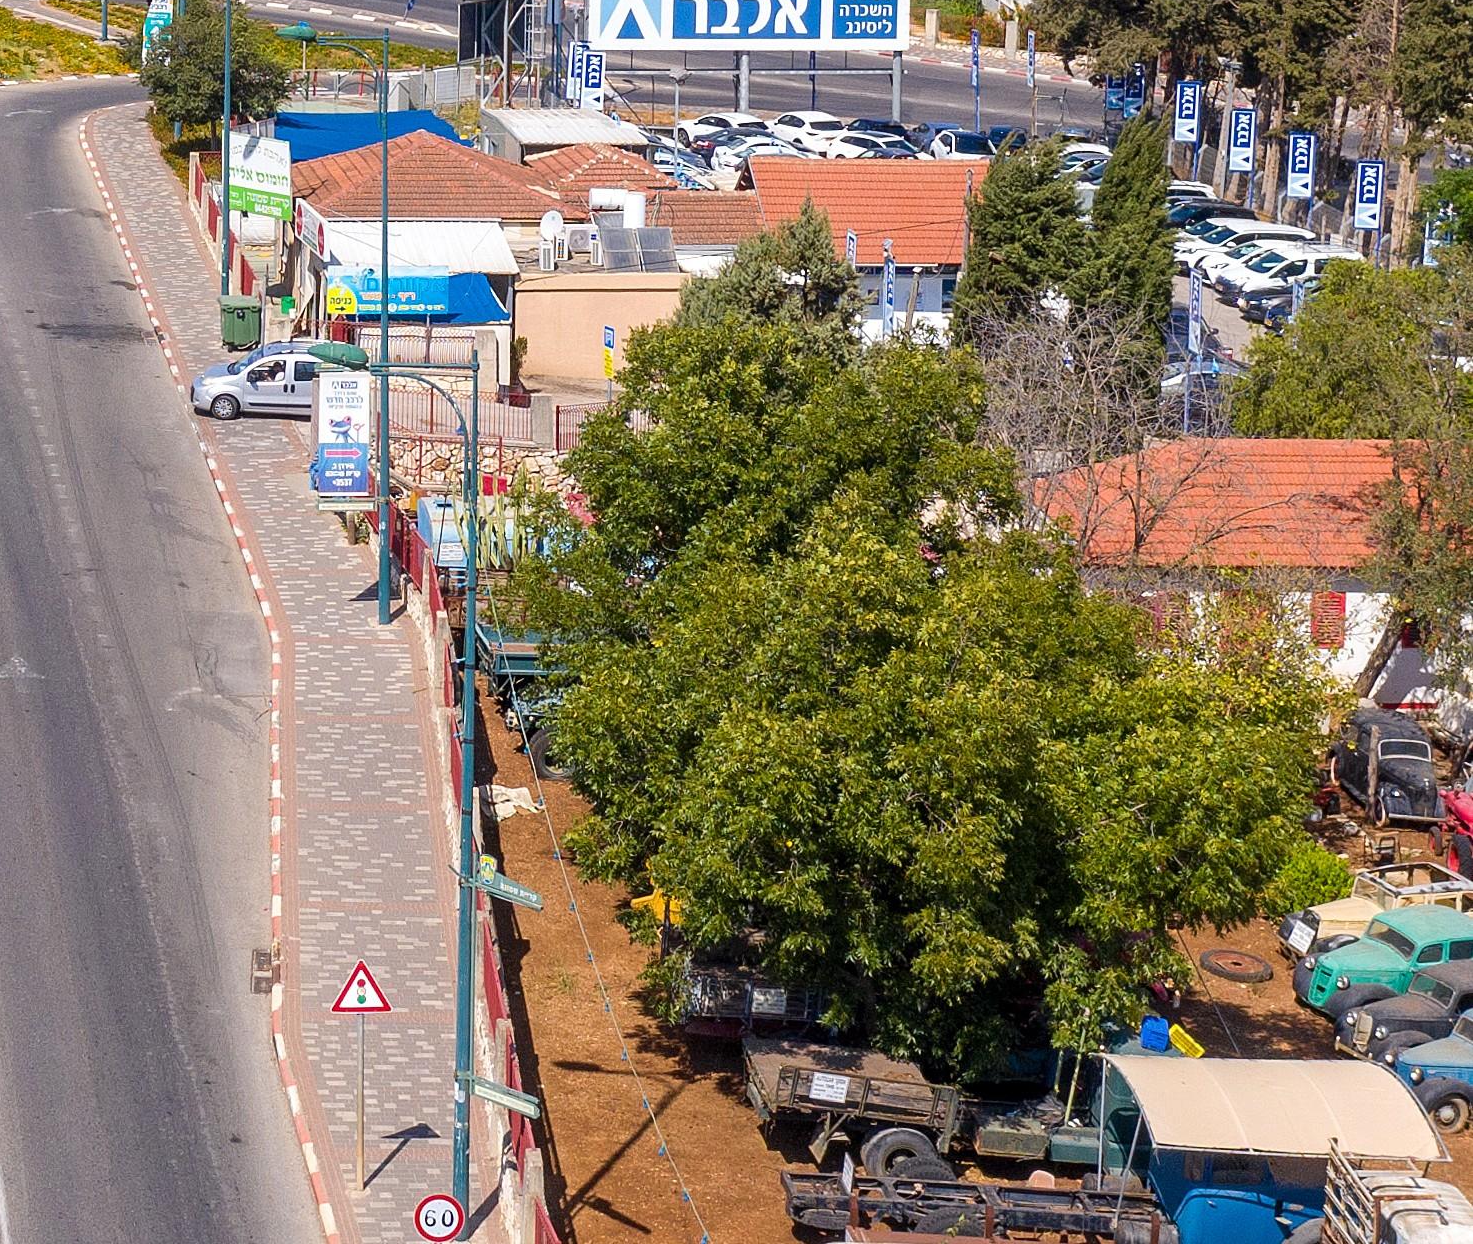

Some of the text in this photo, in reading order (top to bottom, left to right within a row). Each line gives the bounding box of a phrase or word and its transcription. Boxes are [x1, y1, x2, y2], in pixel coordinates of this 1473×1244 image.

[839, 3, 893, 18] השכרה
[845, 19, 893, 35] ליסינג
[588, 56, 601, 86] אלבר
[1181, 86, 1195, 118] אלבר
[1236, 114, 1250, 146] אלבר
[1294, 138, 1309, 172] אלבר
[255, 171, 289, 187] חומוס
[1362, 166, 1378, 202] אלבר
[425, 1209, 454, 1227] 60
